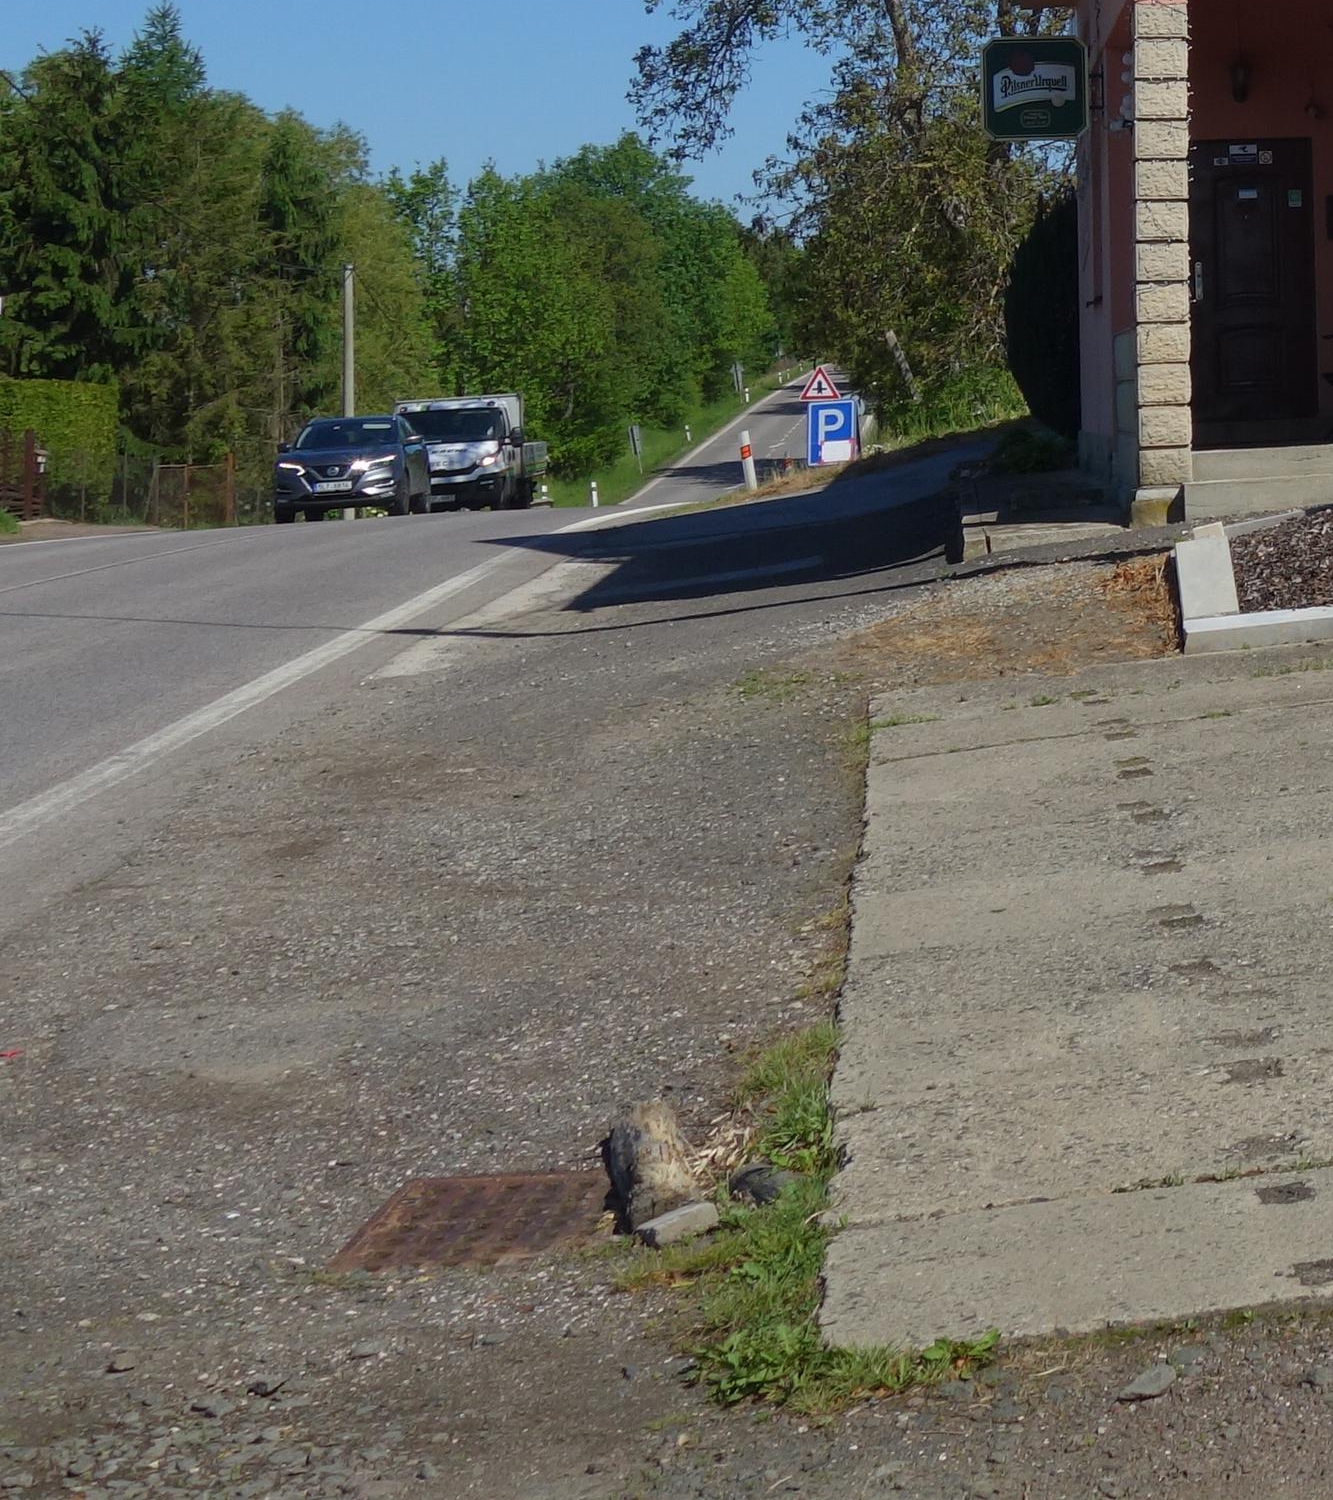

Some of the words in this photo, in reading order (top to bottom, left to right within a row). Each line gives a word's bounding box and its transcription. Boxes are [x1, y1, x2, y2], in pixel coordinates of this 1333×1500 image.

[1000, 75, 1035, 99] Pilsner
[1033, 74, 1068, 92] Urquell
[818, 408, 845, 446] P
